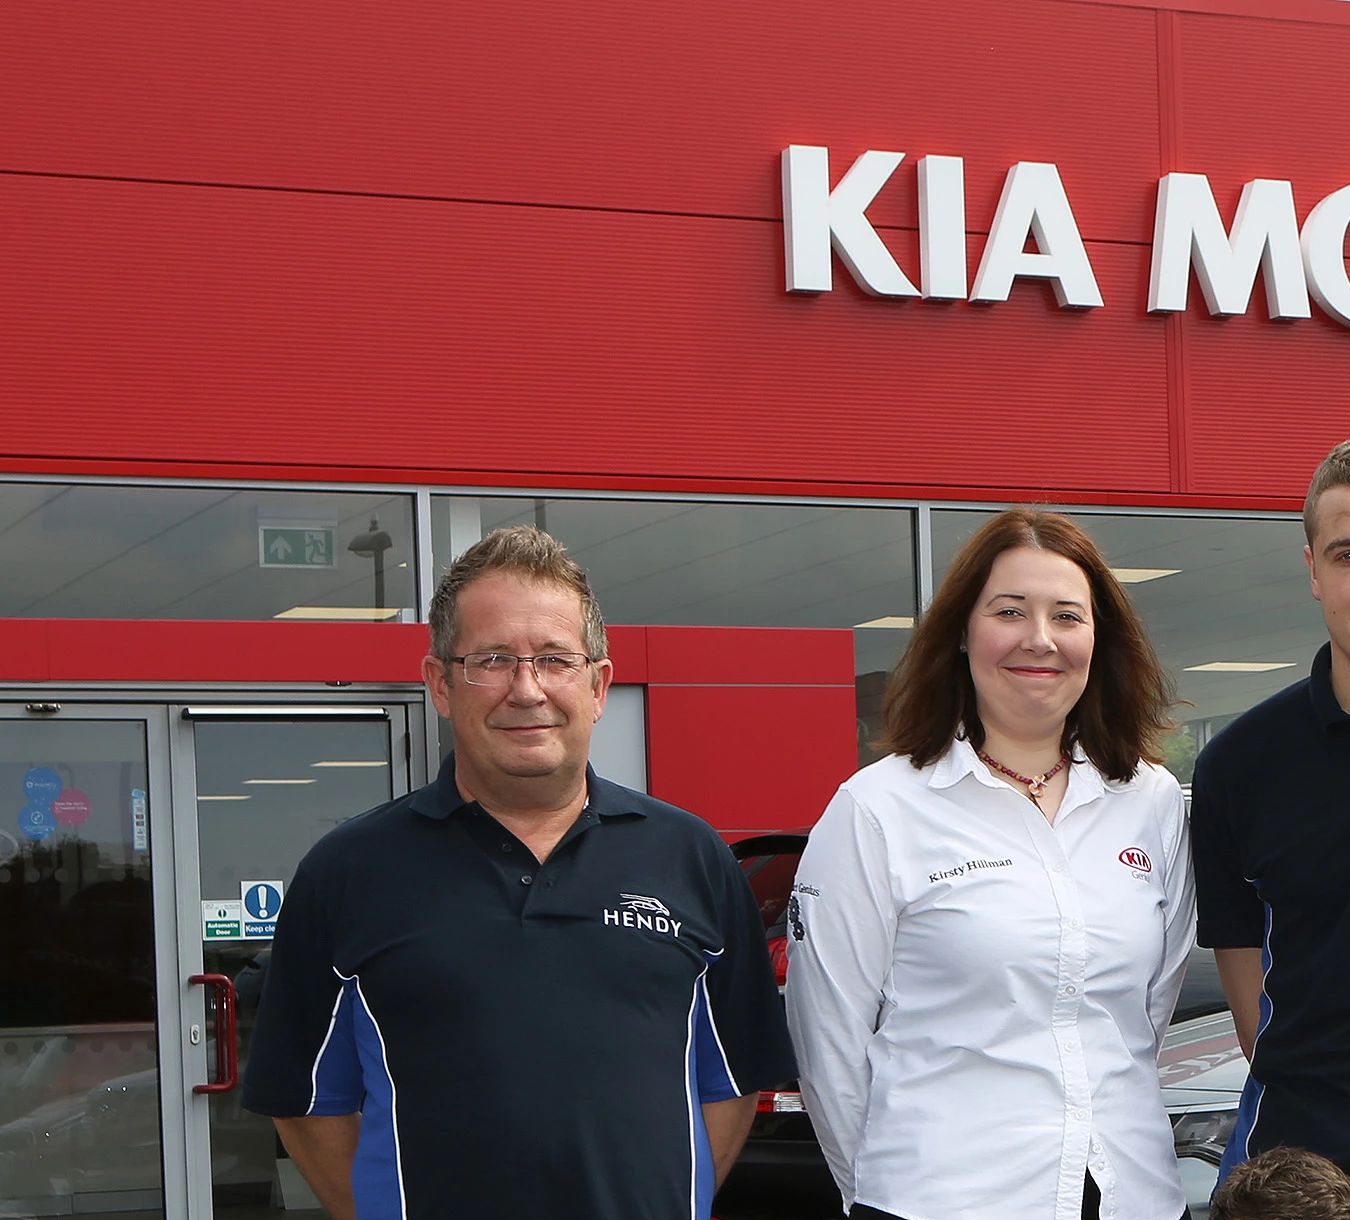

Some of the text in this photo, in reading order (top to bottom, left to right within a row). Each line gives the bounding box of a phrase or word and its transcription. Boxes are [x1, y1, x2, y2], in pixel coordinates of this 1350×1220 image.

[781, 144, 1104, 310] KIA
[928, 858, 1013, 884] Kirsty Hillman
[1125, 851, 1150, 870] KIA
[245, 924, 276, 934] Keep cle
[603, 908, 682, 938] HENDY
